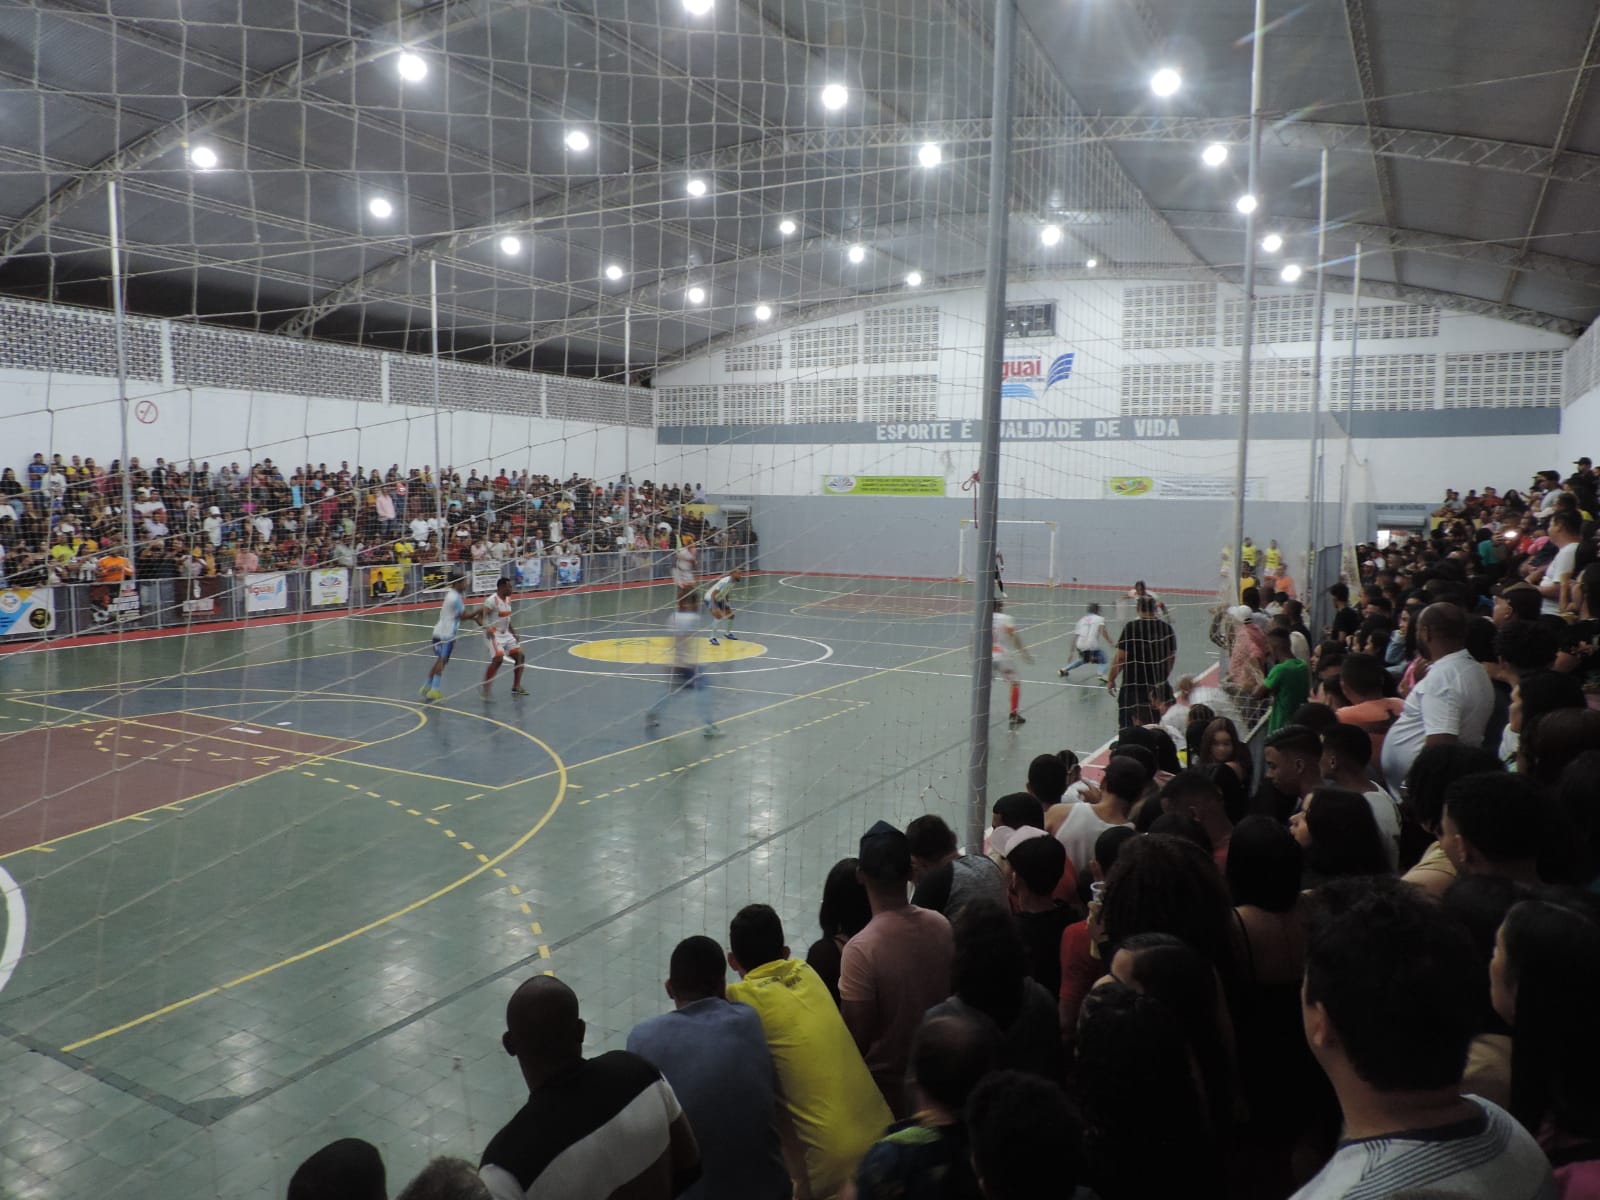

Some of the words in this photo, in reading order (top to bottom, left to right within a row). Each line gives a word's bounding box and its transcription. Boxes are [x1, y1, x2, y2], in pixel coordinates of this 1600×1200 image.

[876, 423, 952, 441] ESPORTE
[960, 418, 973, 439] É
[1000, 419, 1082, 439] UALIDADE
[1095, 420, 1120, 438] DE
[1133, 418, 1180, 437] VIDA
